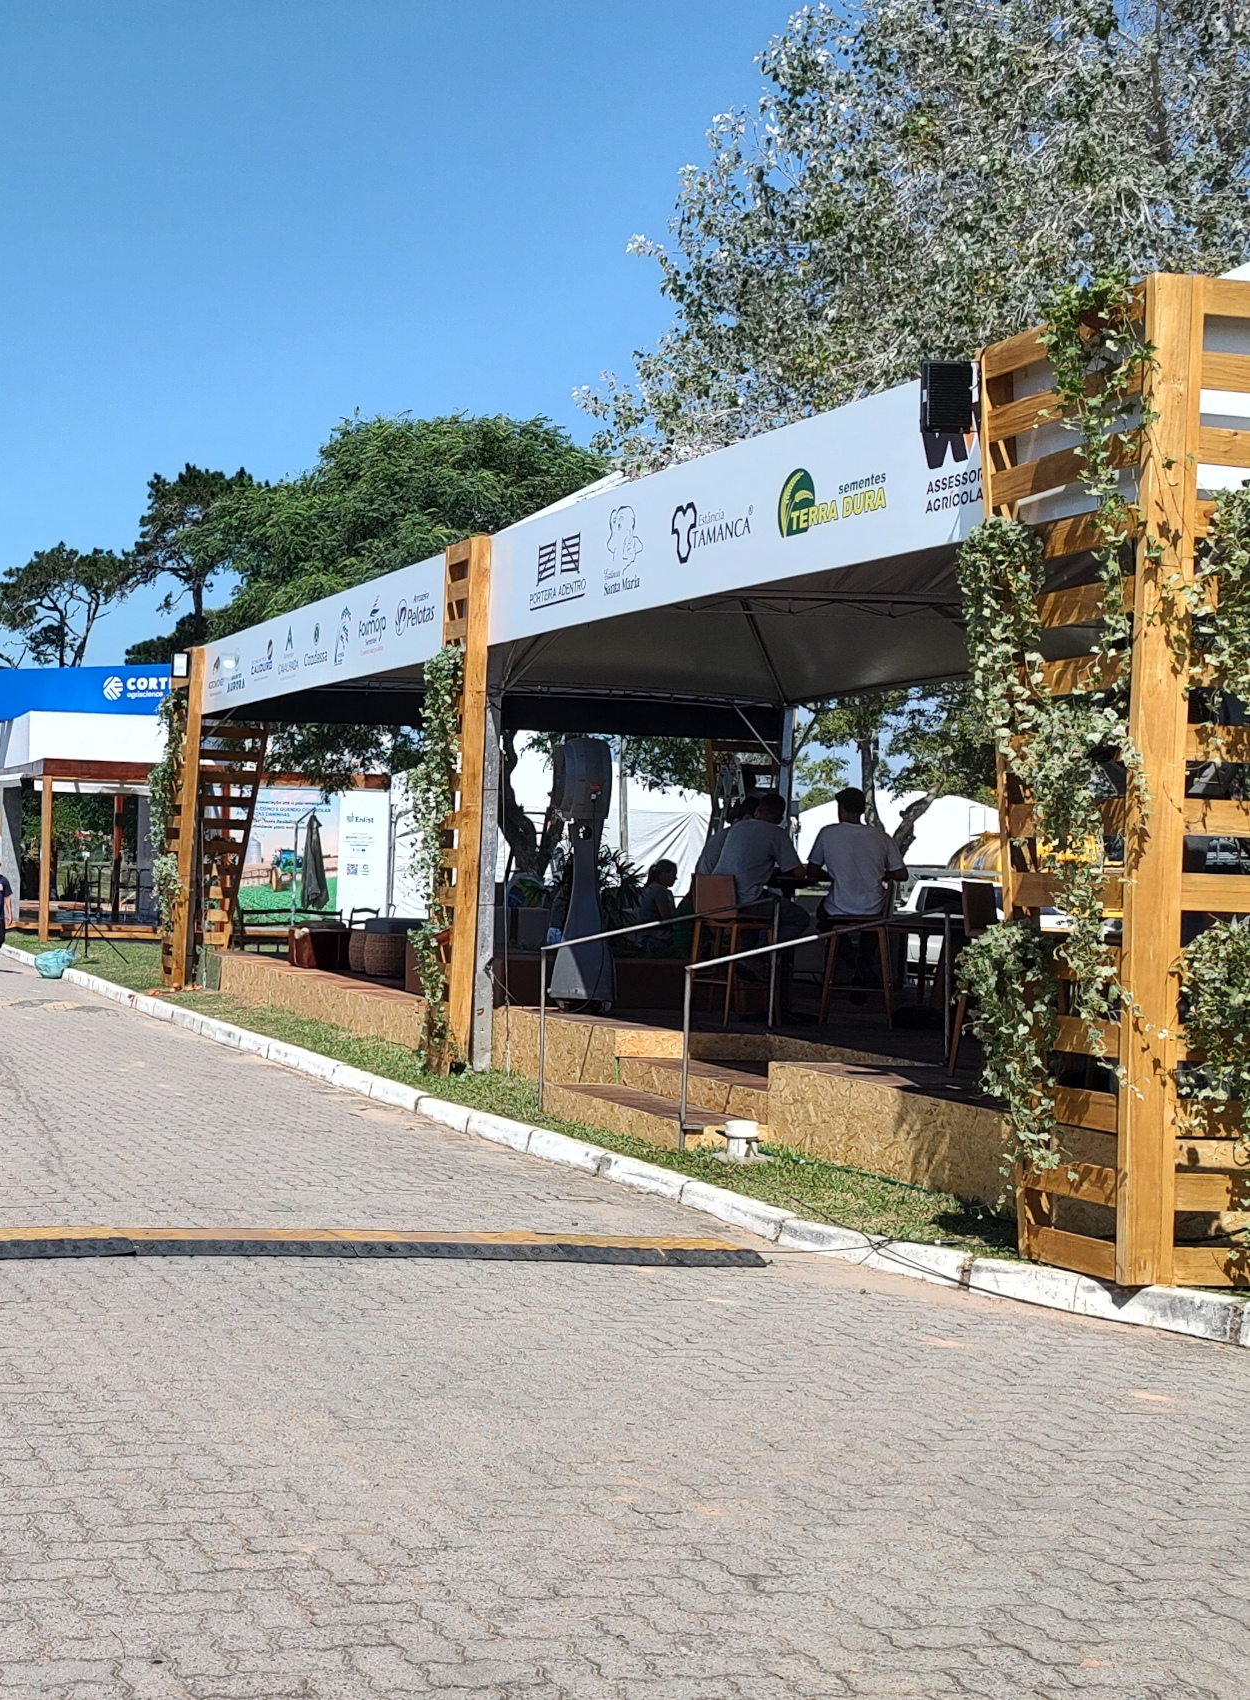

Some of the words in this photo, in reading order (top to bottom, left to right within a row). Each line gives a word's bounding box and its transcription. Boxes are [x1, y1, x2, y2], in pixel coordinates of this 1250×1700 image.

[838, 472, 886, 494] sementes
[791, 500, 838, 530] TERRA
[842, 487, 886, 518] DURA
[692, 516, 751, 549] TAMANCA
[529, 586, 557, 606] PORTEIRA
[558, 578, 586, 597] ADENTRO
[407, 605, 435, 629] Pelotas
[126, 677, 172, 690] CORT
[126, 691, 164, 700] agriscience
